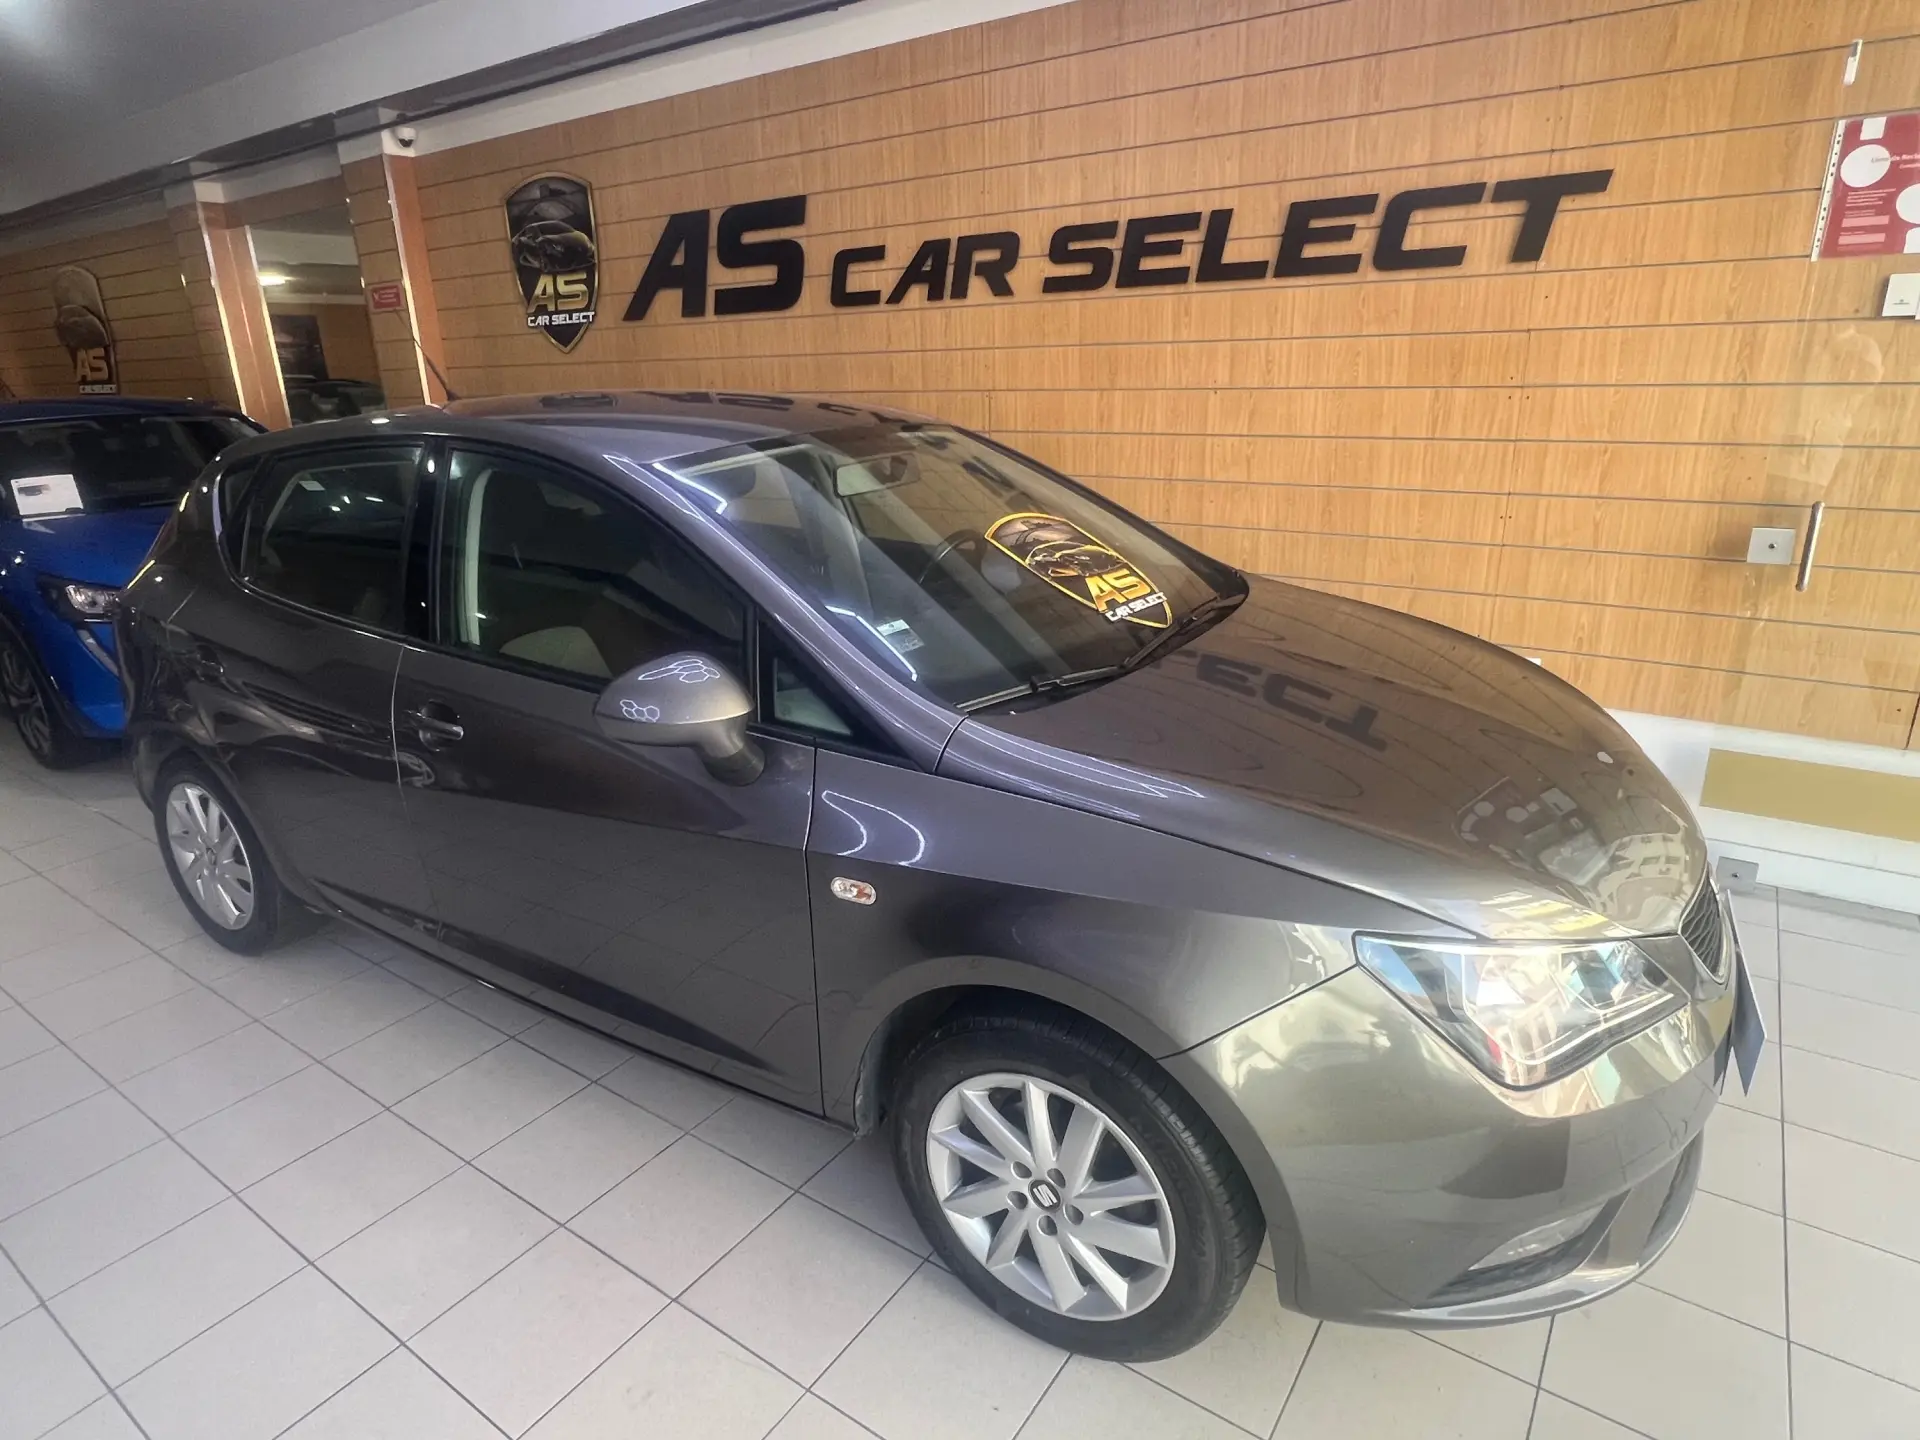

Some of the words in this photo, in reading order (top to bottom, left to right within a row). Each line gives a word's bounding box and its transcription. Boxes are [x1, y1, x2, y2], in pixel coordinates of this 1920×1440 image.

[622, 194, 807, 323] AS
[829, 231, 1021, 308] CAR
[1041, 169, 1614, 294] SELECT
[527, 272, 589, 313] AS
[527, 315, 550, 327] CAR
[551, 311, 595, 325] SELECT
[1085, 568, 1151, 613] AS
[1105, 605, 1134, 622] CAR
[1128, 591, 1168, 613] SELECT
